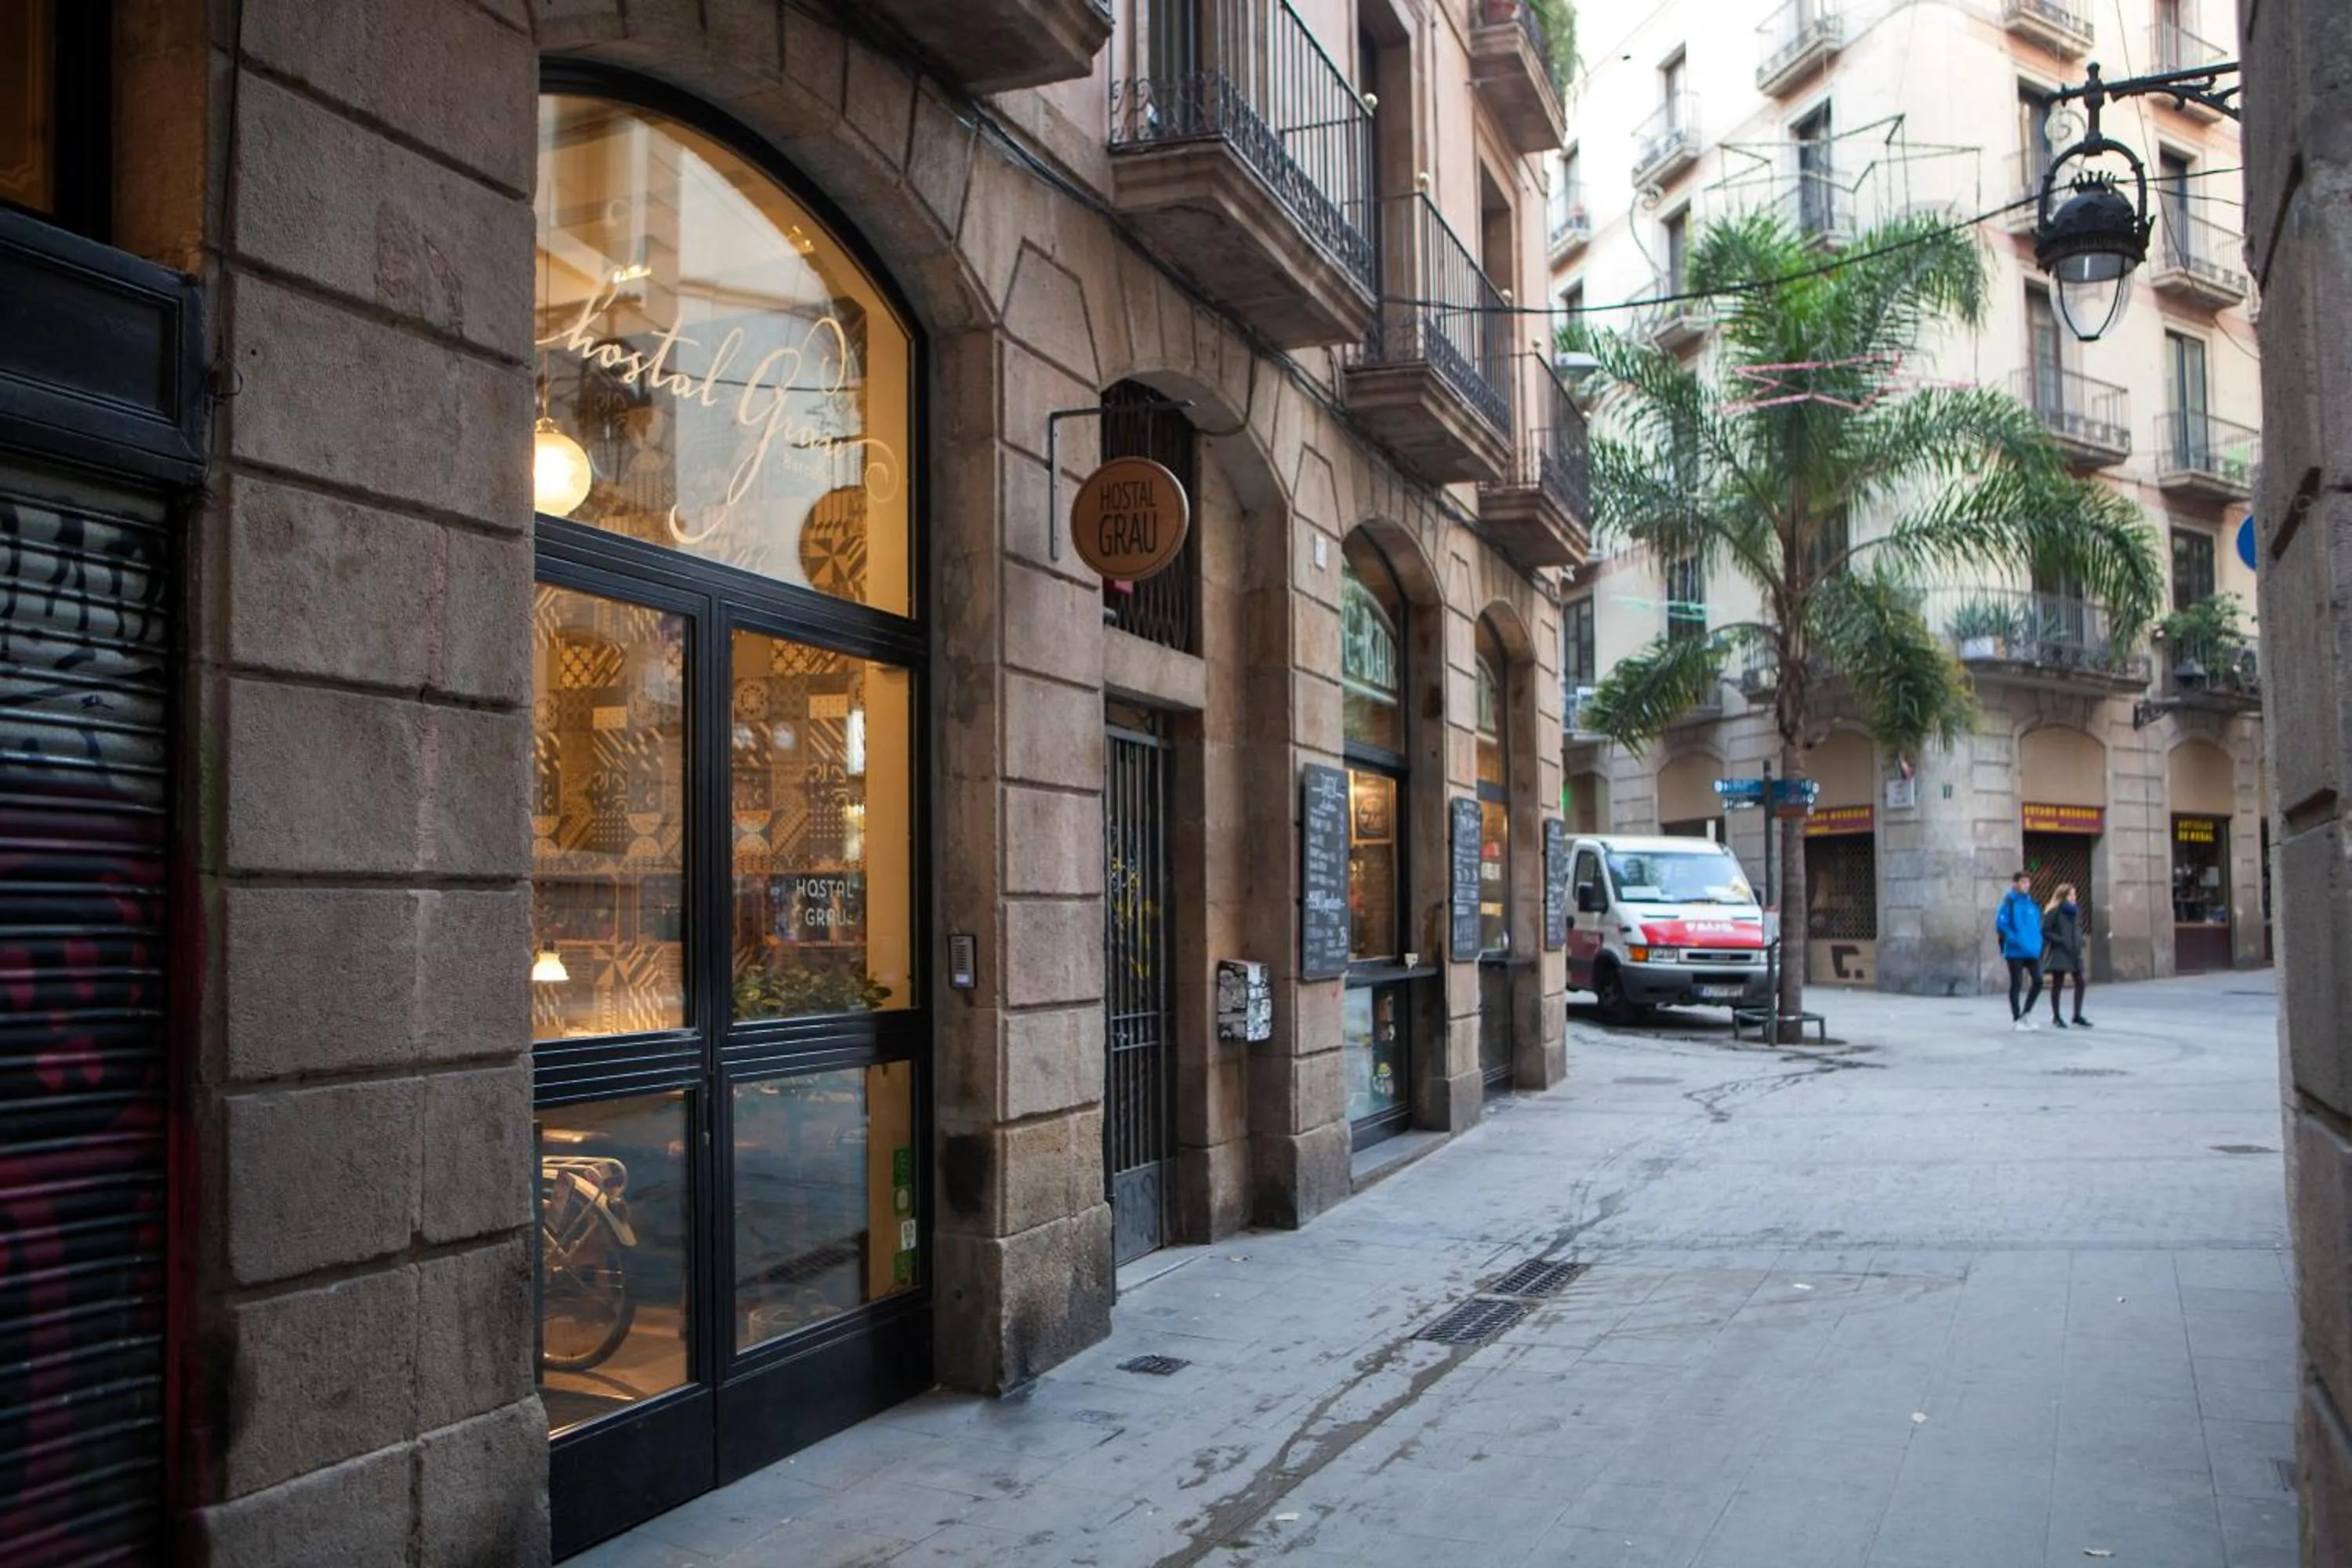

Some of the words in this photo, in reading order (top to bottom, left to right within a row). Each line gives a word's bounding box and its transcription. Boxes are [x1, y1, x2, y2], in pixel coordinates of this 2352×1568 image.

[535, 265, 743, 407] hostal
[1099, 481, 1157, 510] HOSTAL
[1098, 512, 1158, 557] GRAU
[795, 877, 854, 898] HOSTAL
[804, 906, 847, 927] GRAU
